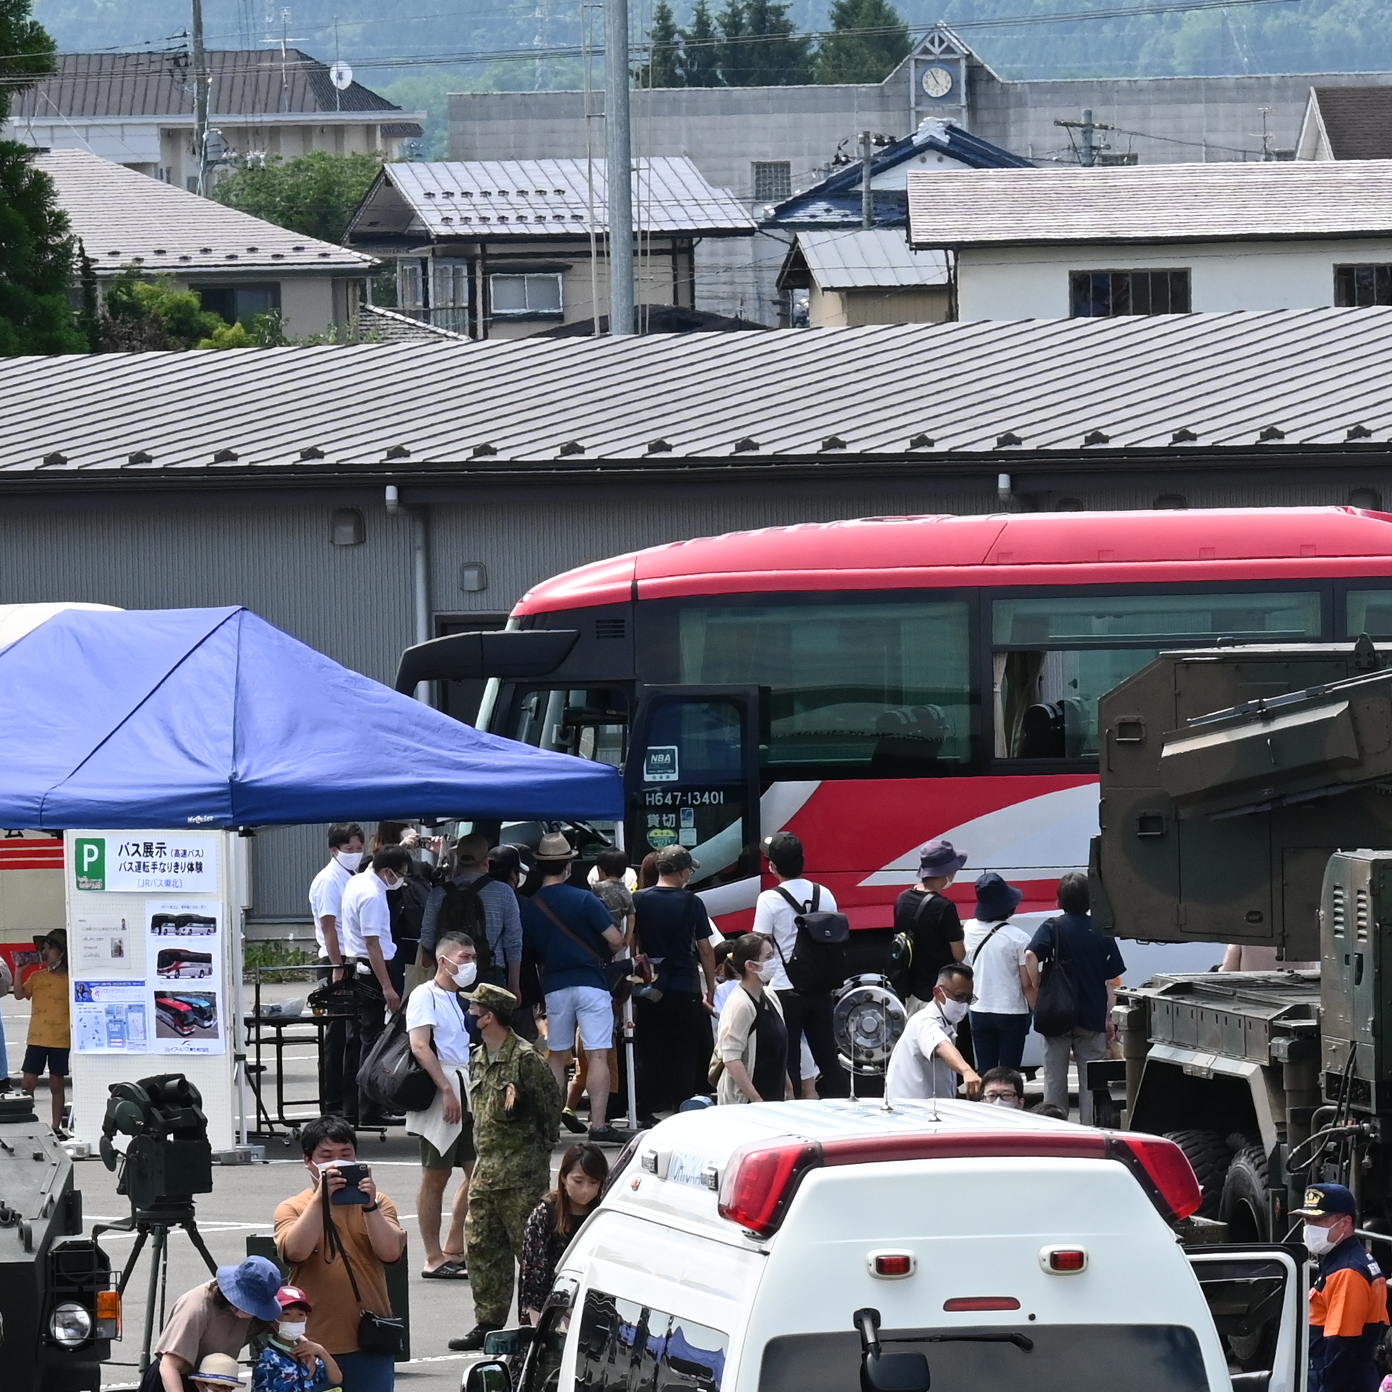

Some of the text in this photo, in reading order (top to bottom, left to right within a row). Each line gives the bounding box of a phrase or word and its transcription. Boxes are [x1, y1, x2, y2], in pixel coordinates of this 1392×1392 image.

[651, 754, 671, 763] NBA
[646, 791, 724, 806] H647-13401
[647, 814, 676, 828] 貸切
[118, 842, 167, 858] バス展示
[83, 844, 99, 872] P
[119, 861, 203, 873] バス運転手なりきり体験
